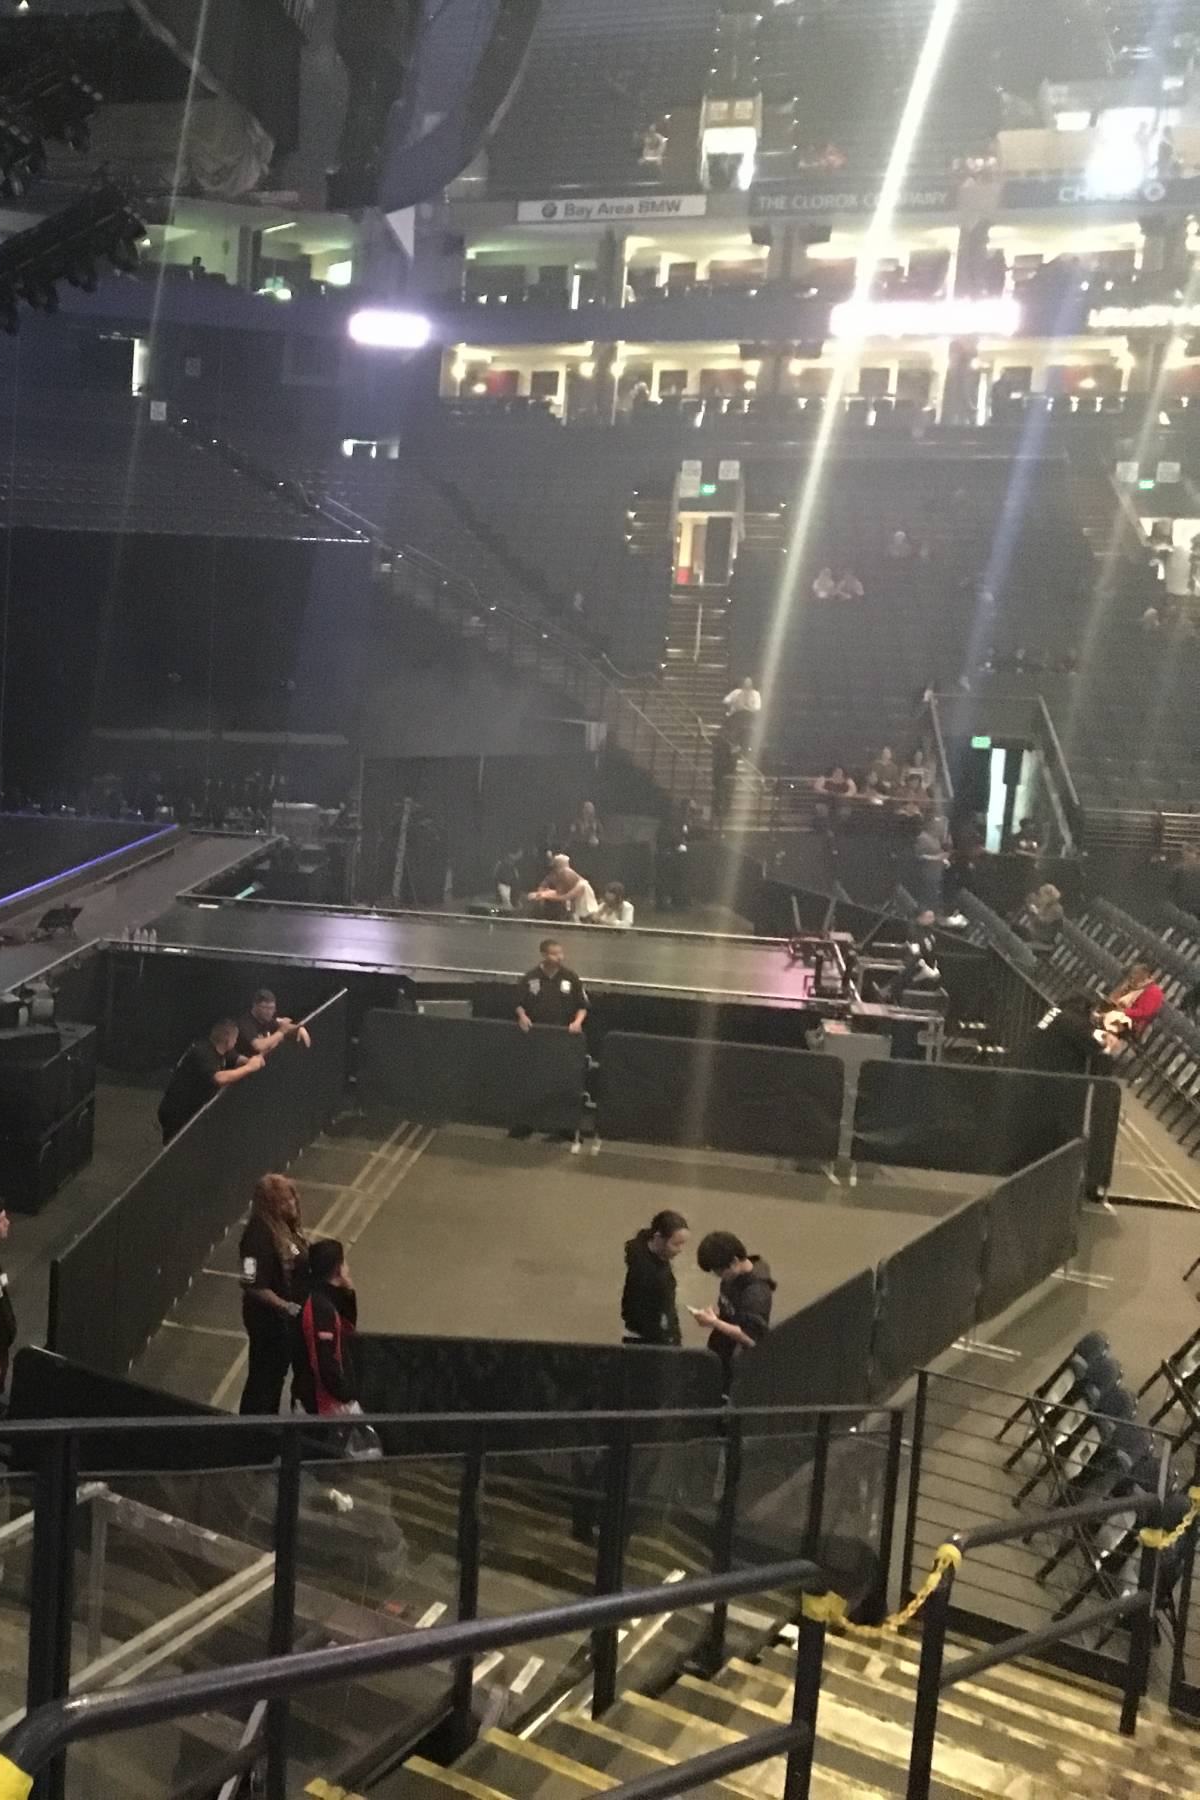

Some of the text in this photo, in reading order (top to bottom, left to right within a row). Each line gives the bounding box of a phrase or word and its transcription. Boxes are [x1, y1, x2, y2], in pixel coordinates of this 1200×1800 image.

[564, 200, 682, 219] Bay Area BMW
[758, 192, 949, 210] THE CLOROX CPANY
